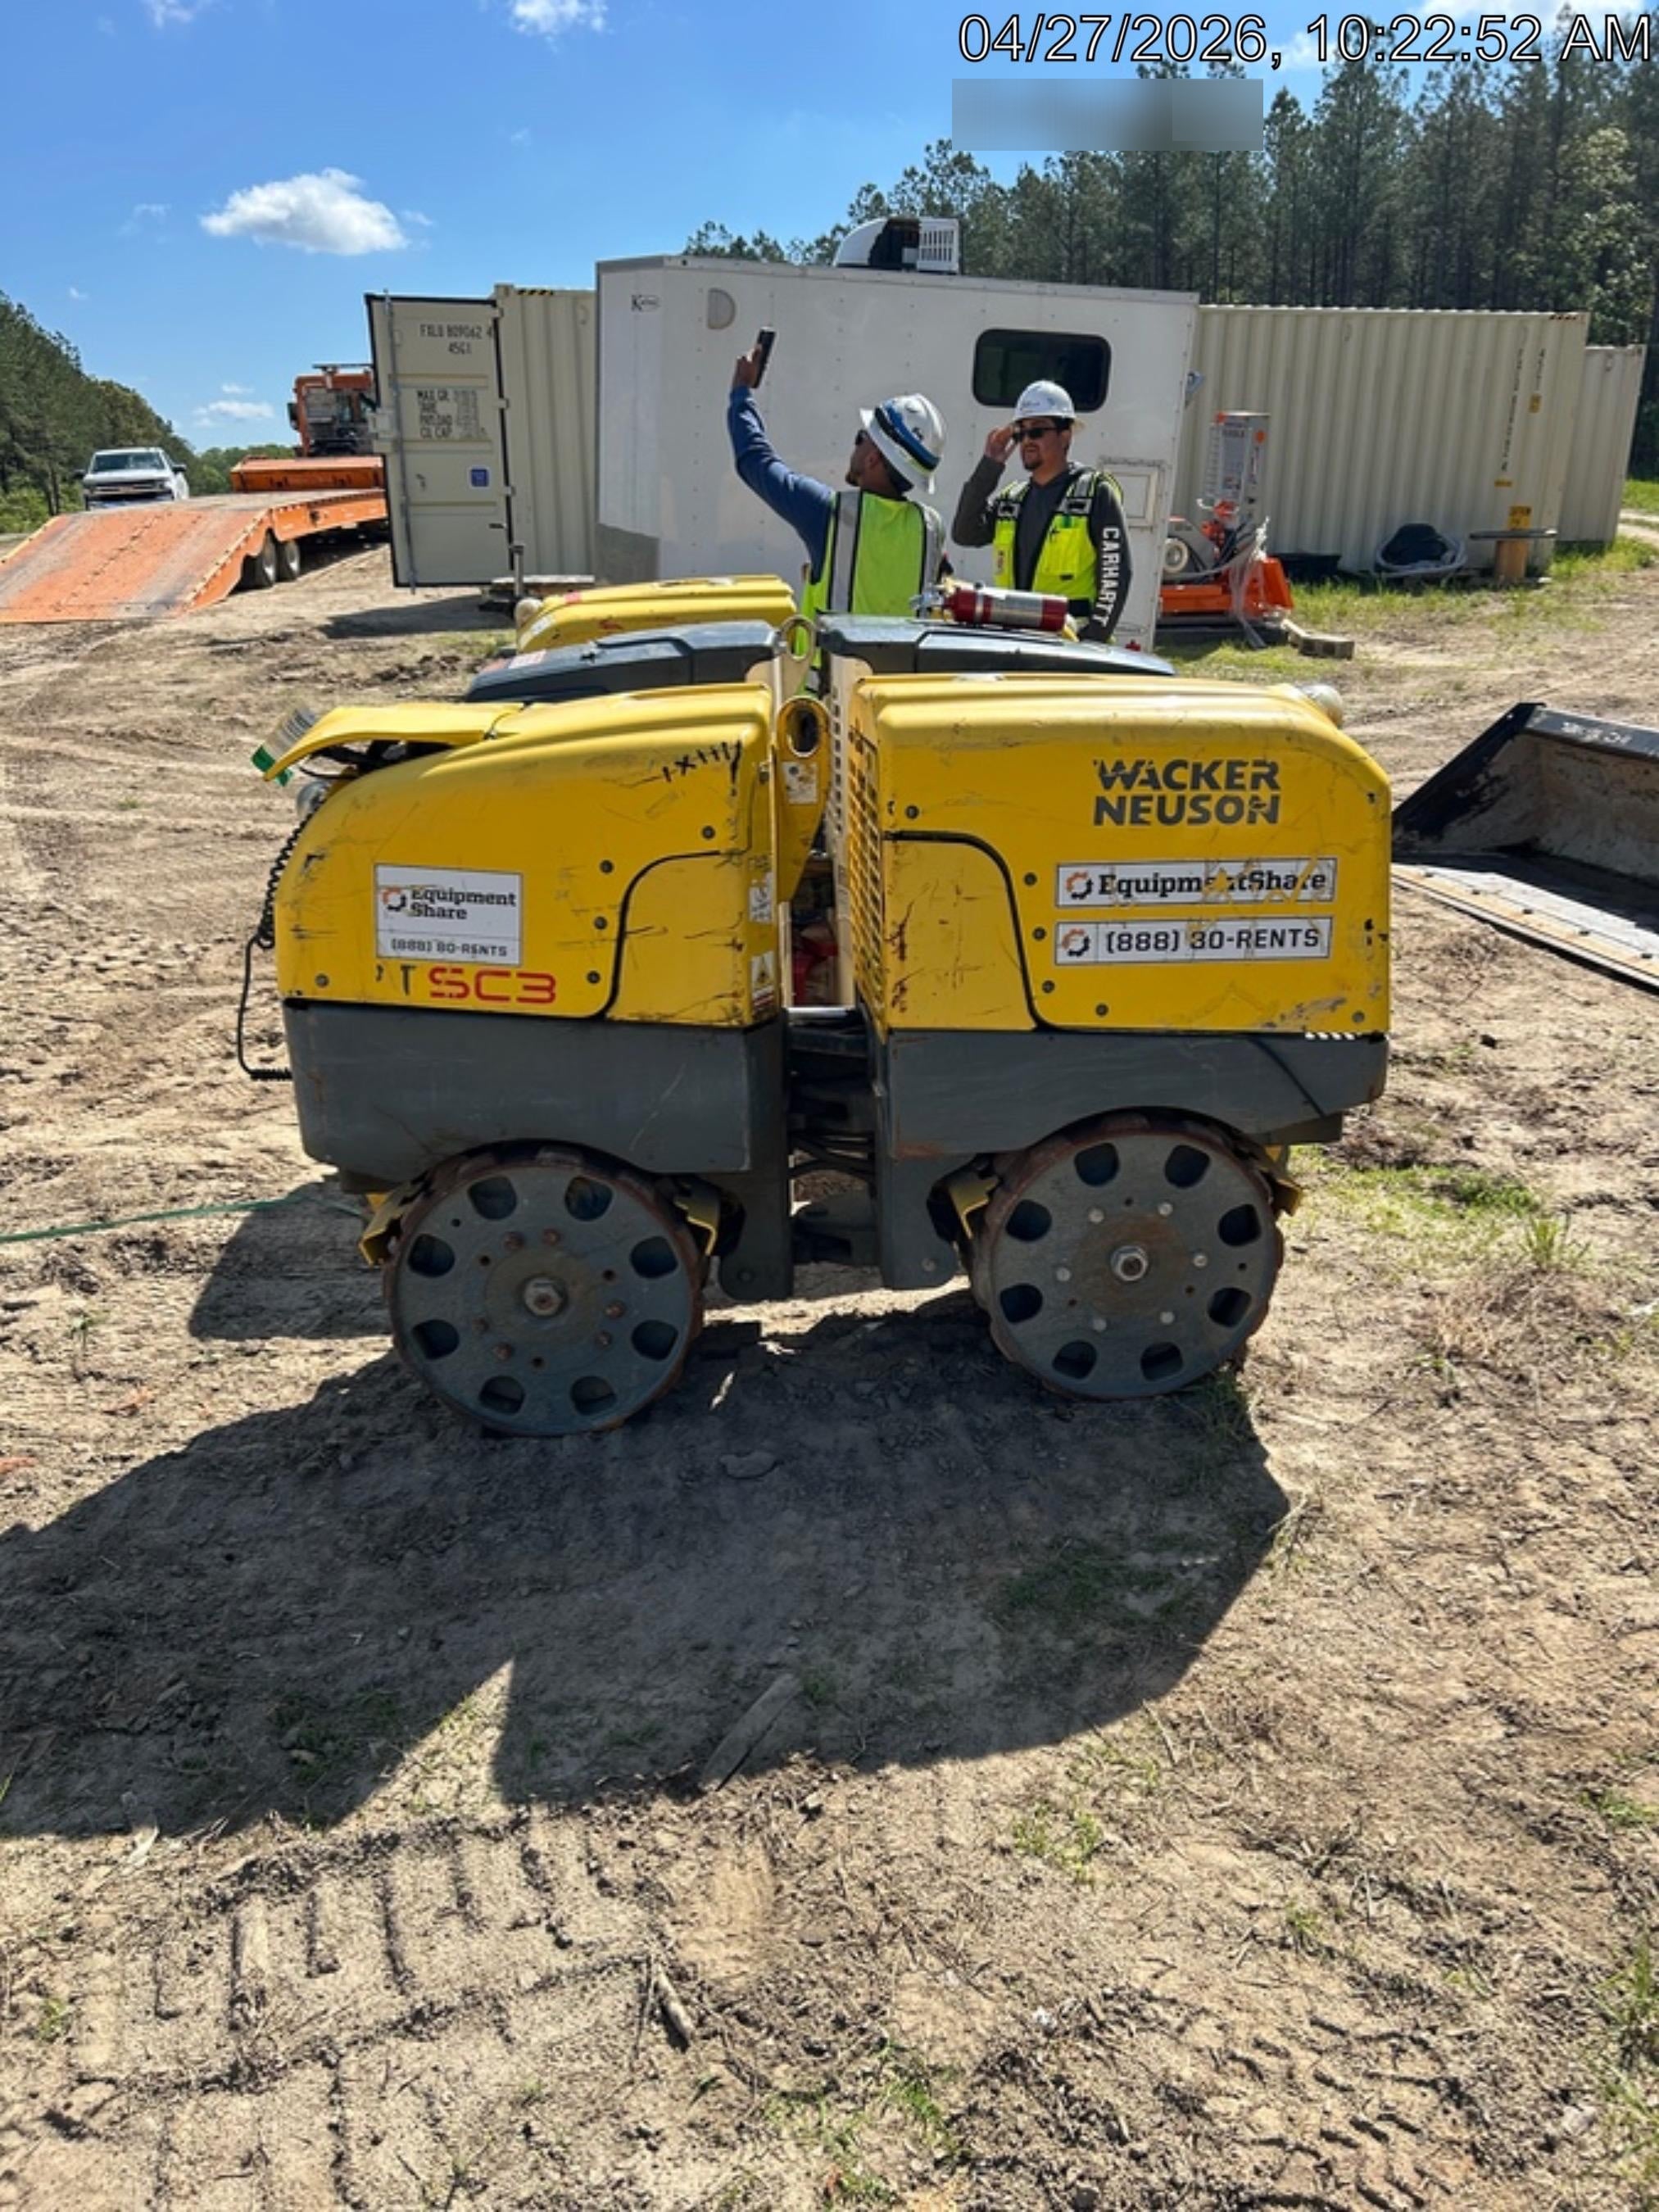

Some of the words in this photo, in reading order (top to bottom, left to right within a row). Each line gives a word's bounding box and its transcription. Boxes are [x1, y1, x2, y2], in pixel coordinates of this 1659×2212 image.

[1091, 527, 1119, 628] CARHARTT
[1093, 759, 1281, 792] WACKER
[1093, 794, 1281, 827] NEUSON
[410, 903, 468, 919] Share
[411, 887, 516, 907] Equipment
[1107, 928, 1180, 954] (888)
[1190, 928, 1319, 950] 30-RENTS
[428, 967, 557, 1004] SC3
